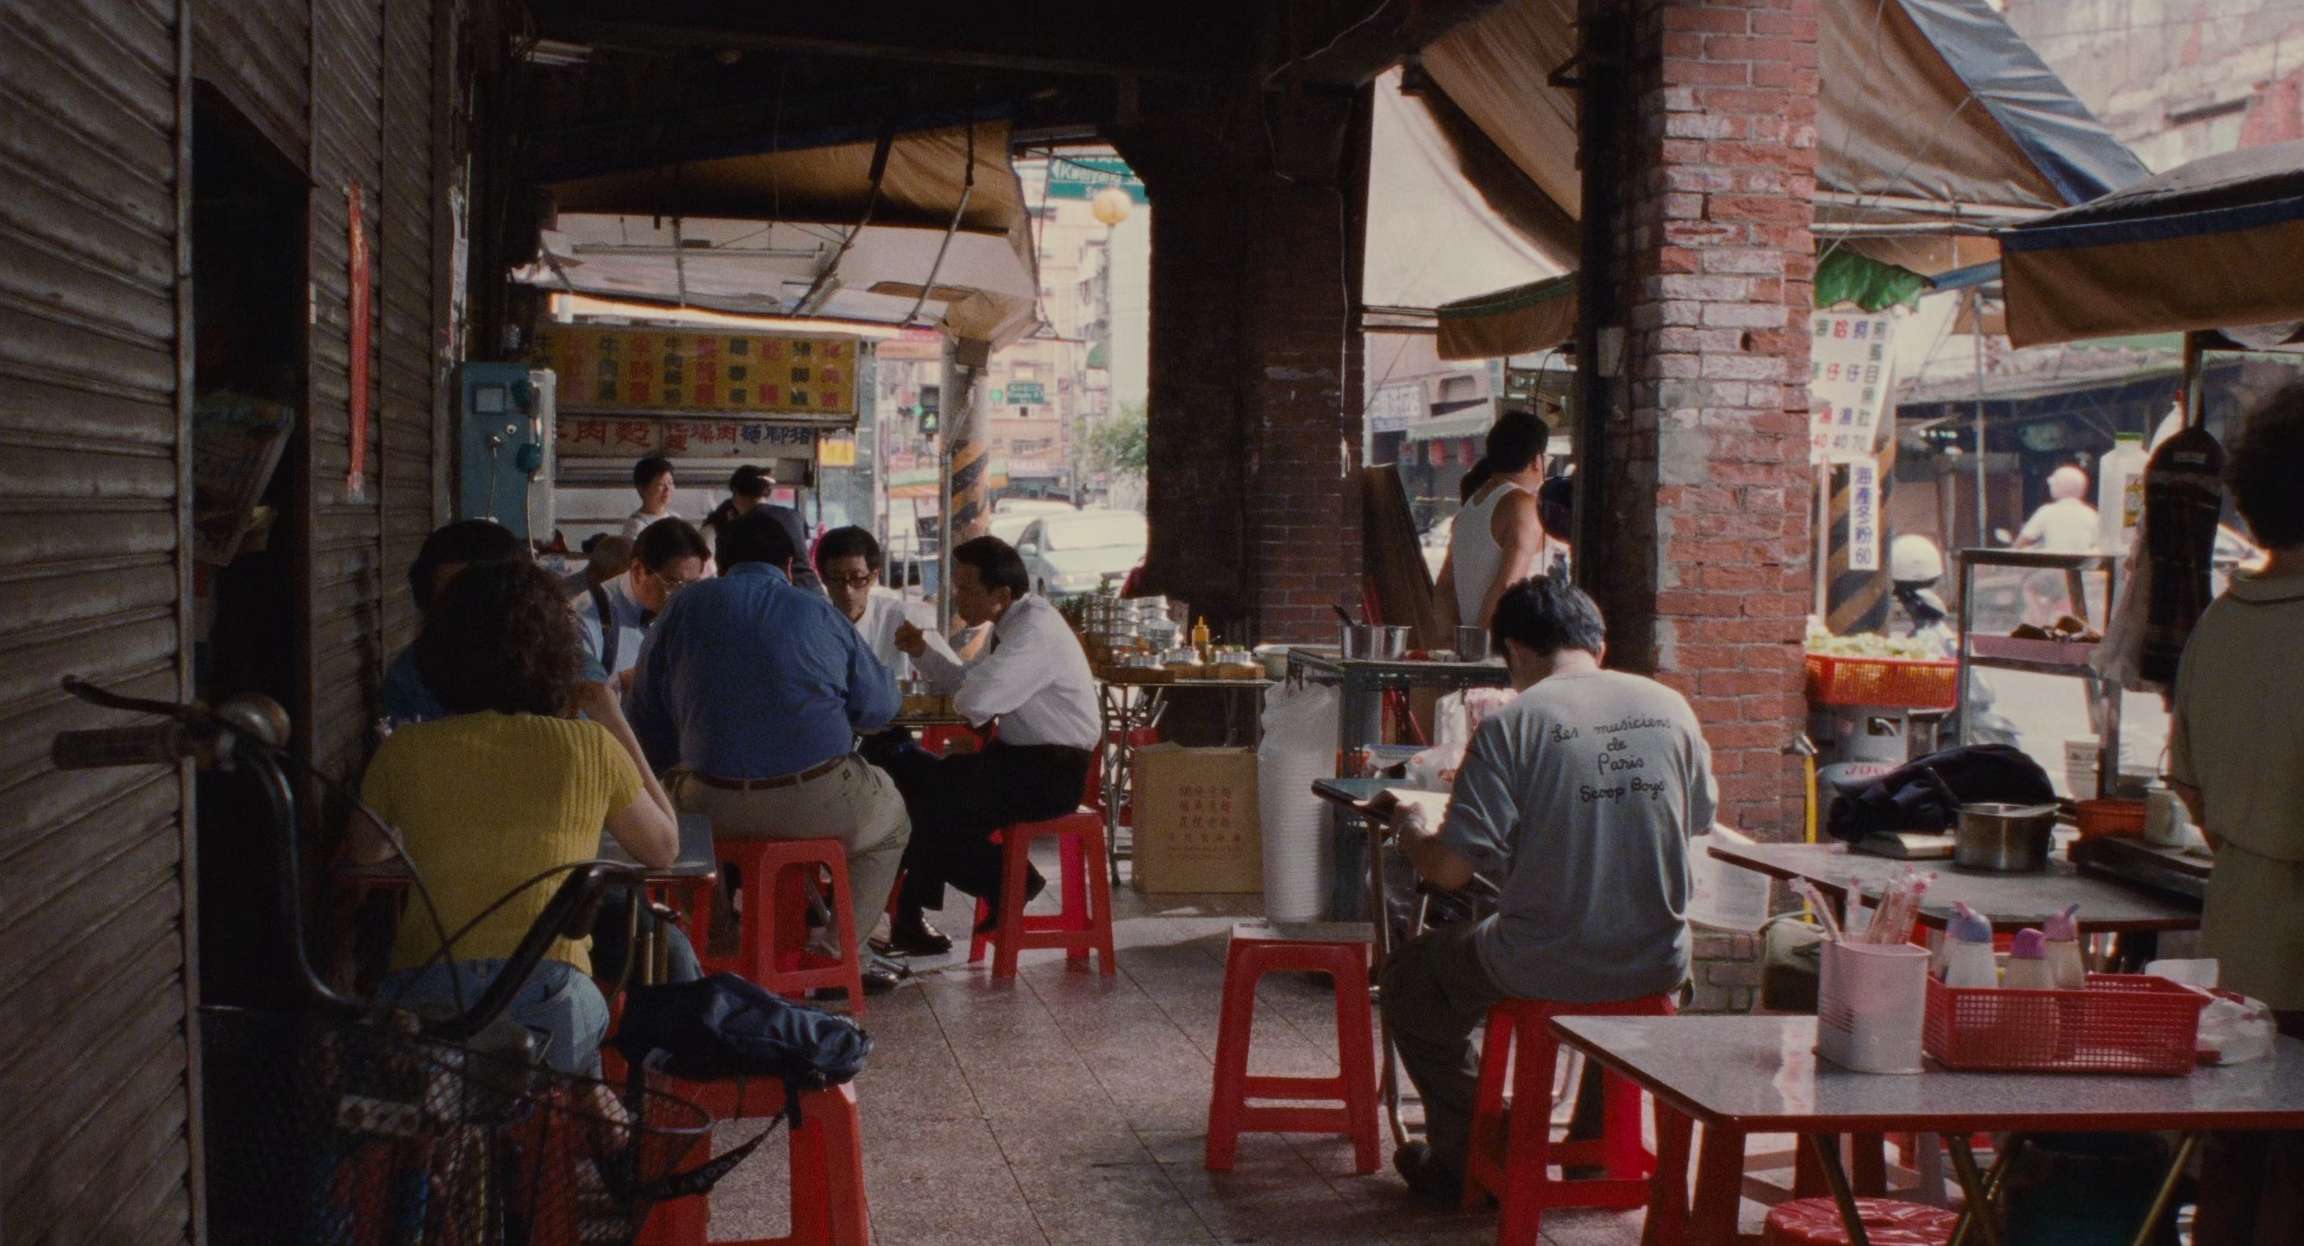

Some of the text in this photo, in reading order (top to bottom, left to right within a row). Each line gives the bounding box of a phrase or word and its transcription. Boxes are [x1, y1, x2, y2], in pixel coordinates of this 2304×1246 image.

[1551, 713, 1671, 743] Les musiciens
[1606, 736, 1628, 752] de
[1598, 752, 1644, 776] Paris
[1631, 776, 1665, 801] Boys
